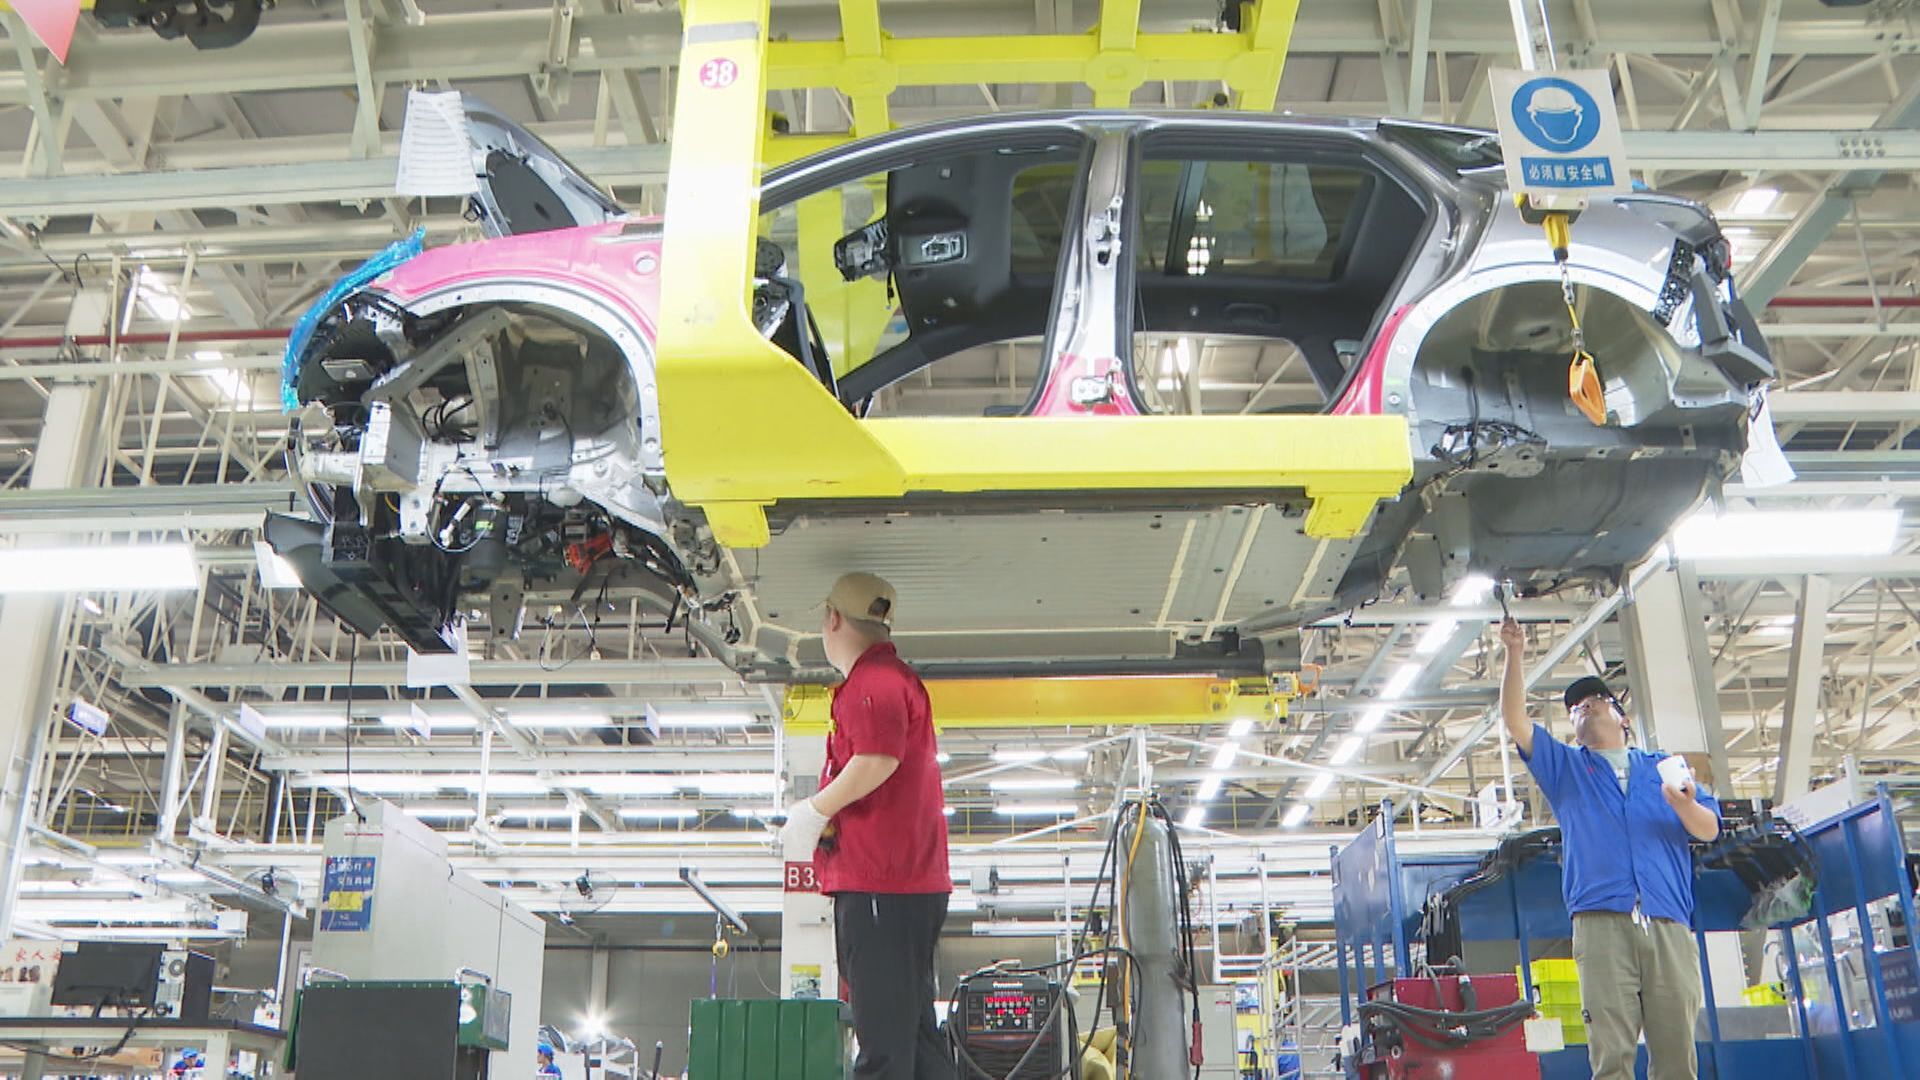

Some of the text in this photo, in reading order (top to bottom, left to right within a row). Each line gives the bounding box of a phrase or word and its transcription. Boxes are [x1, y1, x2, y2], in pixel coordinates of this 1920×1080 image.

[703, 60, 734, 87] 38
[1528, 162, 1607, 181] 必须戴安全帽
[788, 866, 821, 888] B3
